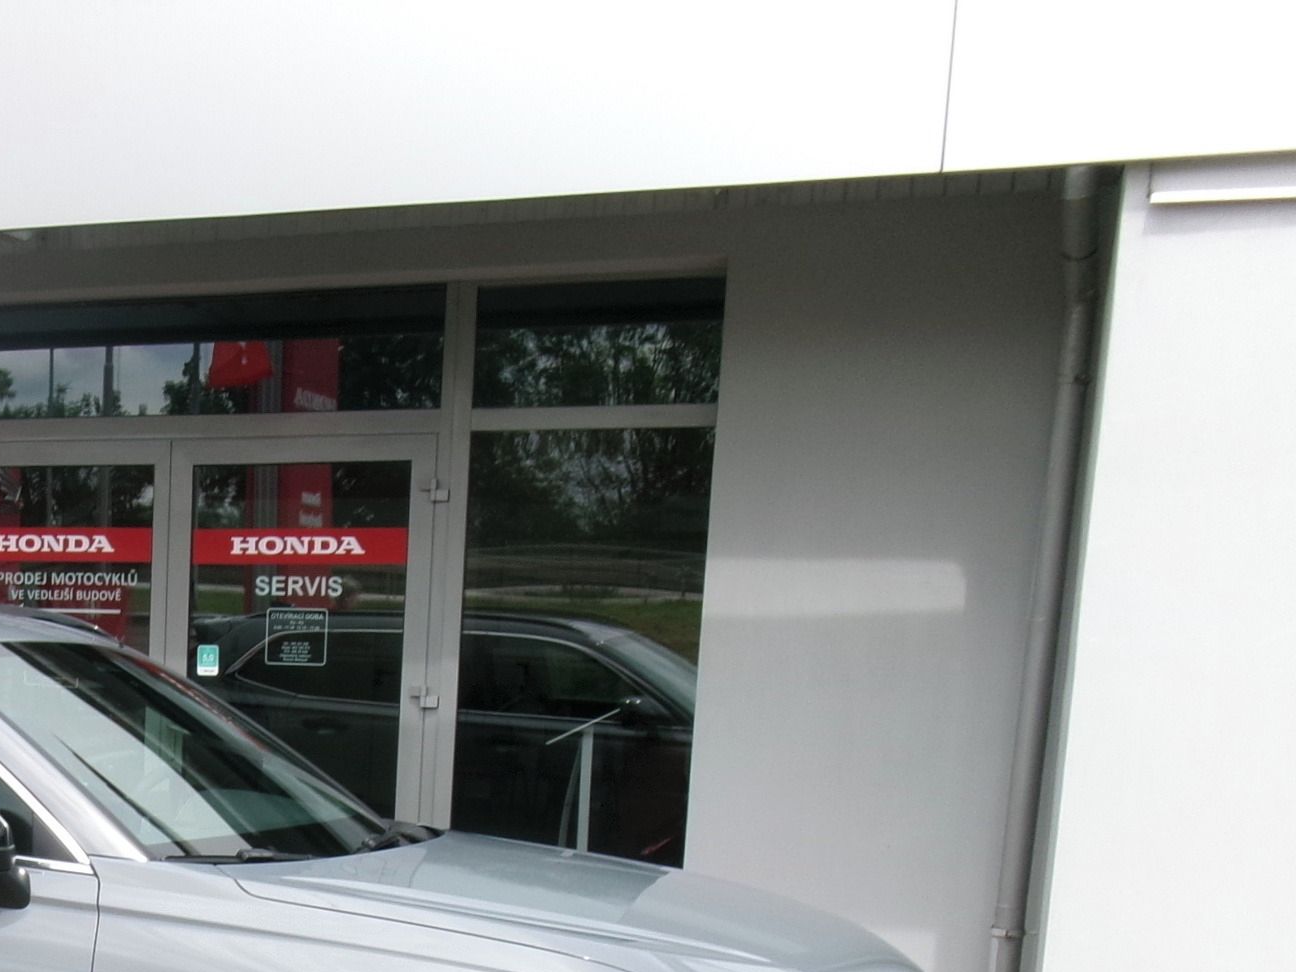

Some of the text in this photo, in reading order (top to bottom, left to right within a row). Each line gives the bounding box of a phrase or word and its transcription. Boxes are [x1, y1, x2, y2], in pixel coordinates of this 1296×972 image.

[230, 536, 366, 555] HONDA
[51, 569, 138, 586] MOTOCYKLŮ
[255, 575, 343, 597] SERVIS
[11, 587, 121, 602] VE VEDLEJŠÍ BUDOVĚ
